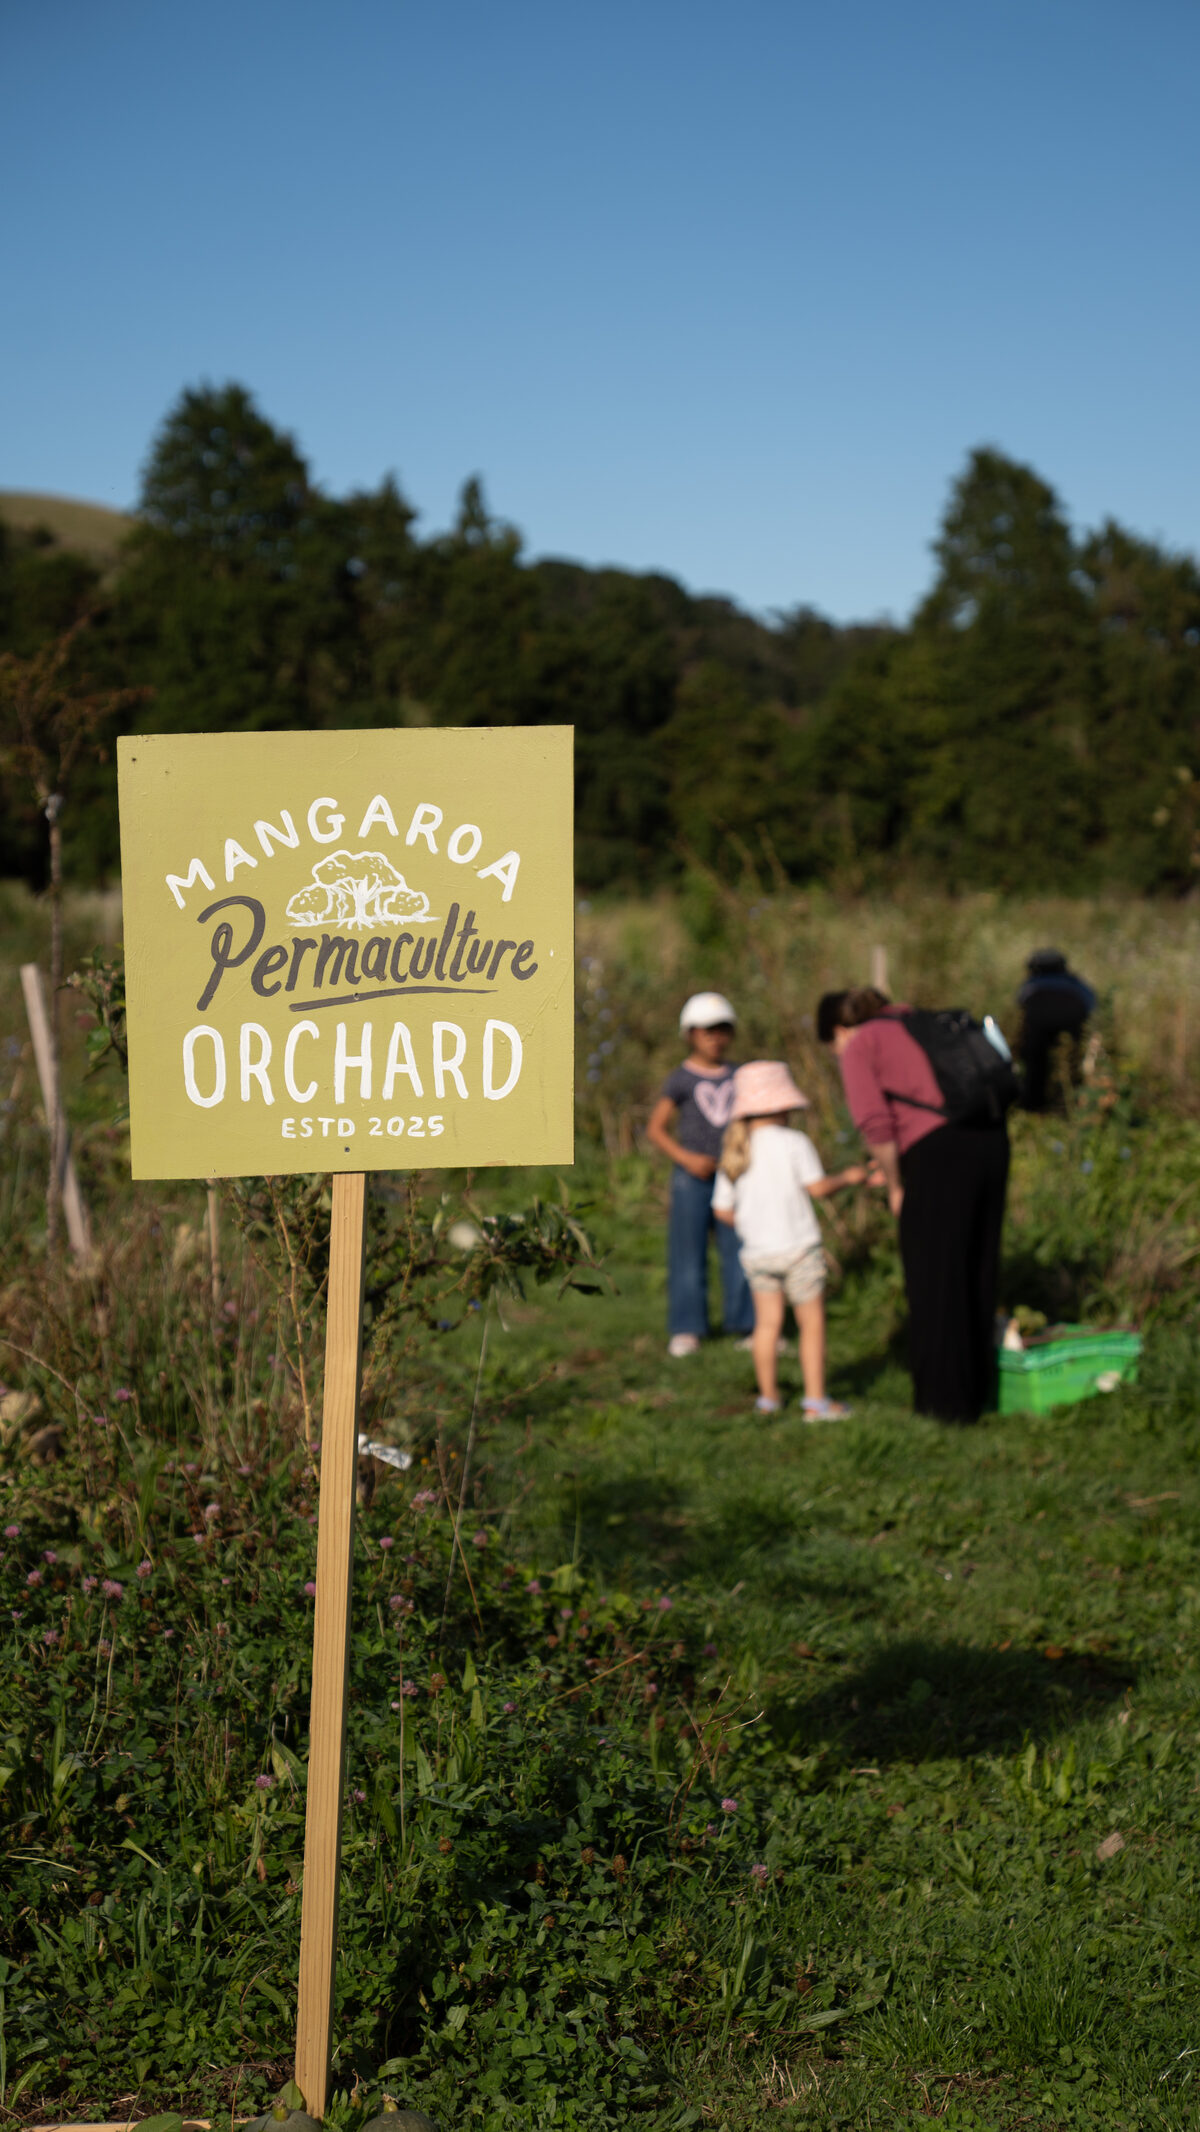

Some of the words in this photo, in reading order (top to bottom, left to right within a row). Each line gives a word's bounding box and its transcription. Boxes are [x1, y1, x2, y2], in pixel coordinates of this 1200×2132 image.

[165, 794, 521, 909] MANGAROA
[197, 895, 538, 1012] Permaculture
[183, 1019, 523, 1108] ORCHARD
[281, 1117, 355, 1138] ESTD
[367, 1115, 445, 1137] 2025
